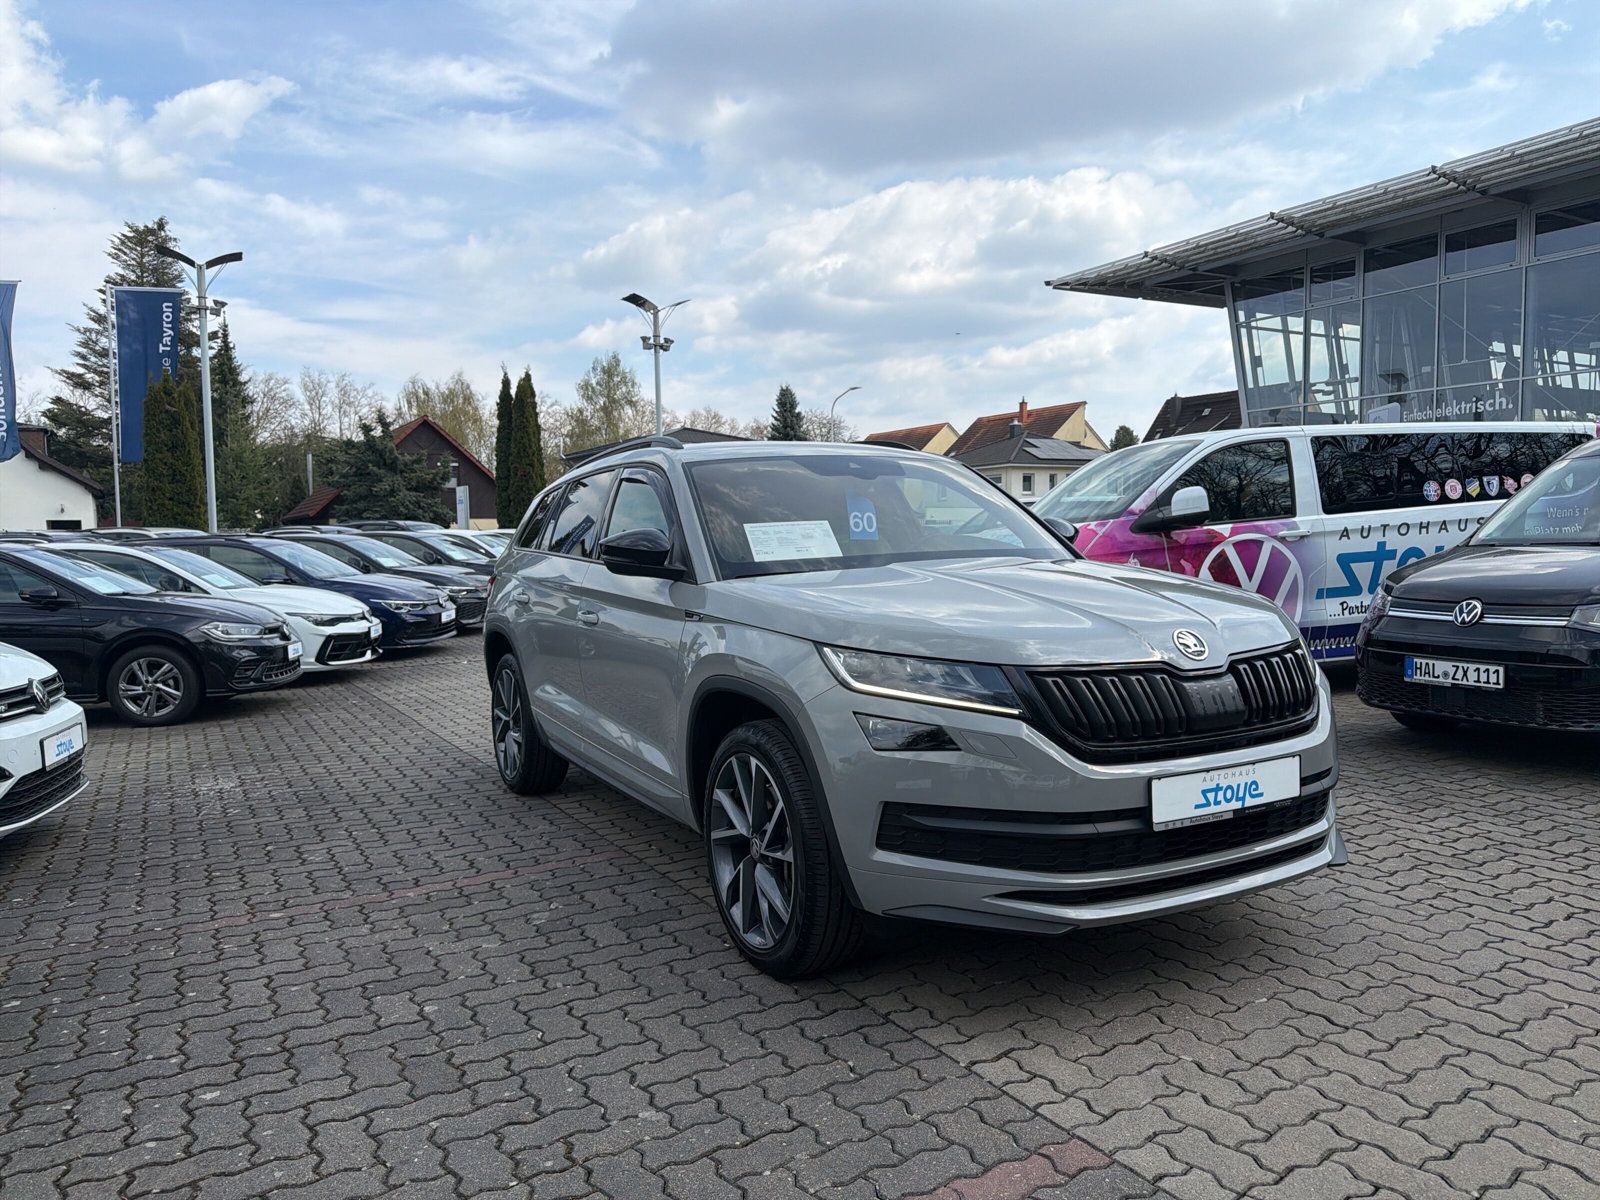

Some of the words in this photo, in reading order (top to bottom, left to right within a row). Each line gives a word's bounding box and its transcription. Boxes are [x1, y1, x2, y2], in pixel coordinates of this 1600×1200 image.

[159, 302, 174, 353] Tayron
[1403, 408, 1432, 421] Einfach
[1436, 391, 1513, 418] elektrisch.
[849, 511, 877, 533] 60
[1338, 517, 1486, 541] AUTOHAUS
[1414, 660, 1440, 679] HAL
[1451, 664, 1470, 683] ZX
[1473, 667, 1501, 686] 111
[1202, 768, 1256, 783] AUTOHAUS
